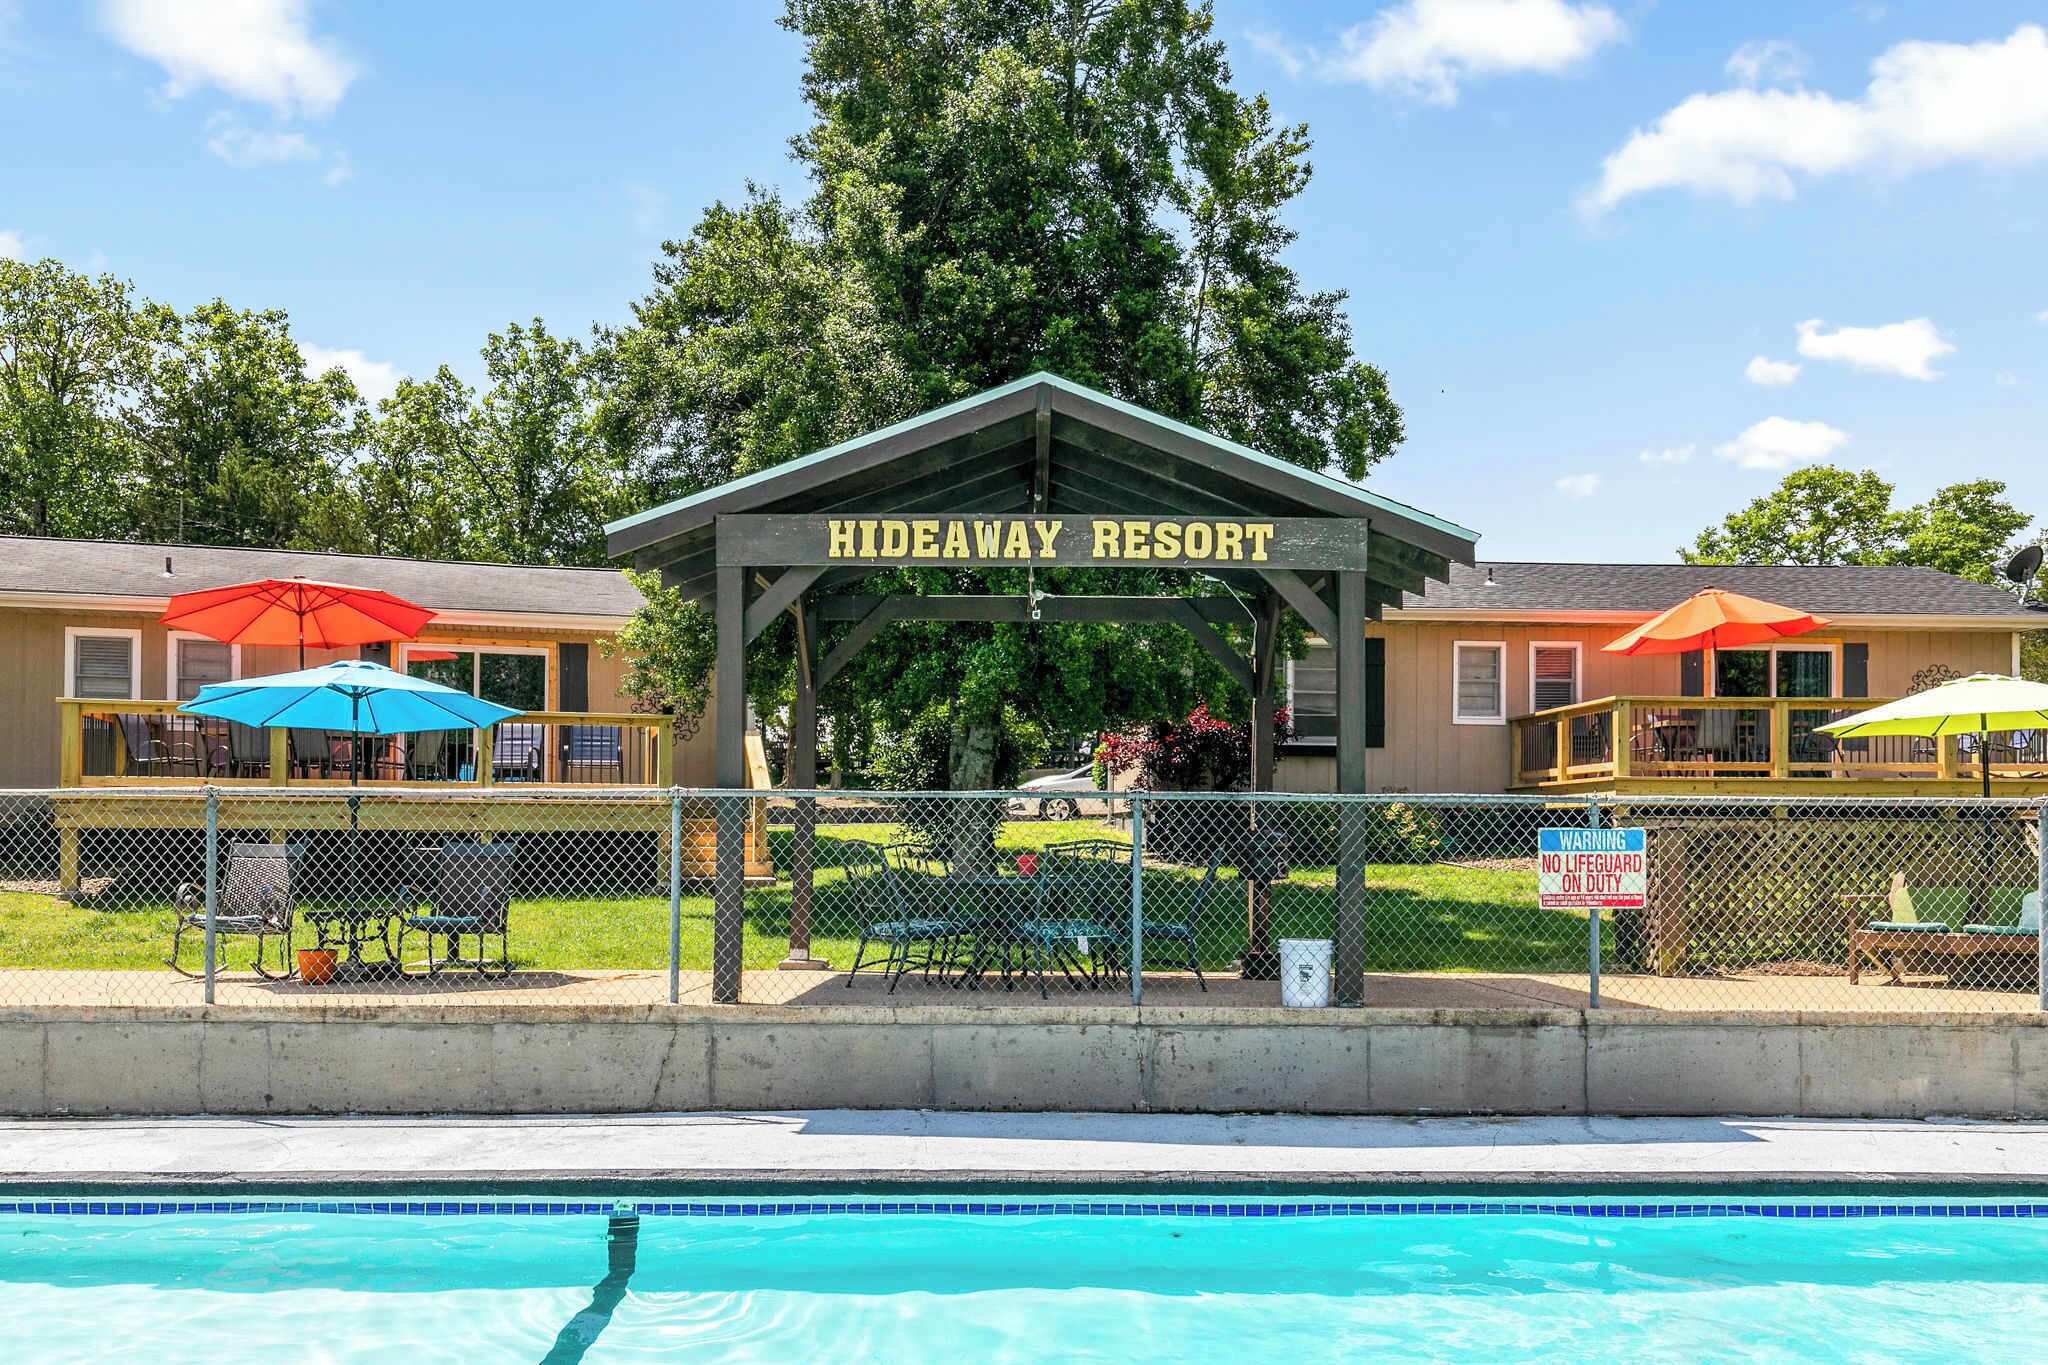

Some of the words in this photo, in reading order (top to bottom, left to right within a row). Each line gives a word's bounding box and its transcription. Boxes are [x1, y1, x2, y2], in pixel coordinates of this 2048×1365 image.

[828, 519, 1062, 558] HIDEAWAY
[1092, 520, 1274, 560] RESORT
[1559, 831, 1626, 850] WARNING
[1542, 854, 1561, 873] NO
[1566, 854, 1642, 873] LIFEGUARD
[1562, 874, 1581, 893] ON
[1586, 874, 1622, 893] DUTY
